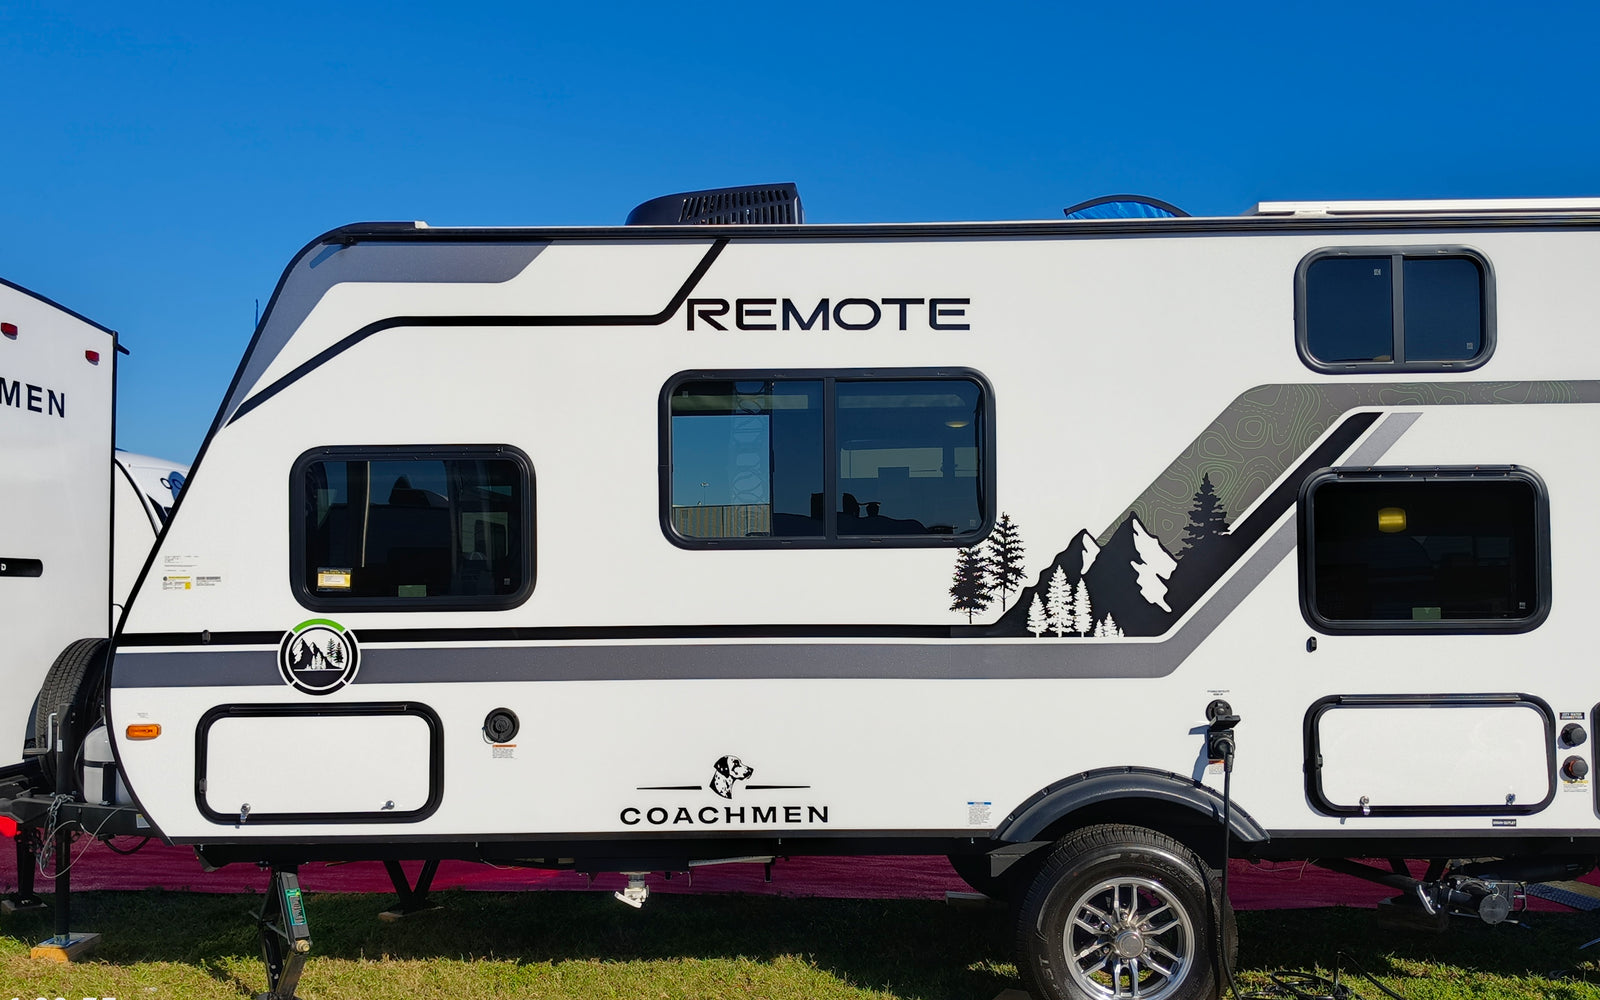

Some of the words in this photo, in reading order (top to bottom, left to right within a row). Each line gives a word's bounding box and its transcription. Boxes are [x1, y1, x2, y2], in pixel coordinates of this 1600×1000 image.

[686, 297, 971, 331] REMOTE
[0, 376, 65, 419] MEN
[619, 806, 829, 825] COACHMEN
